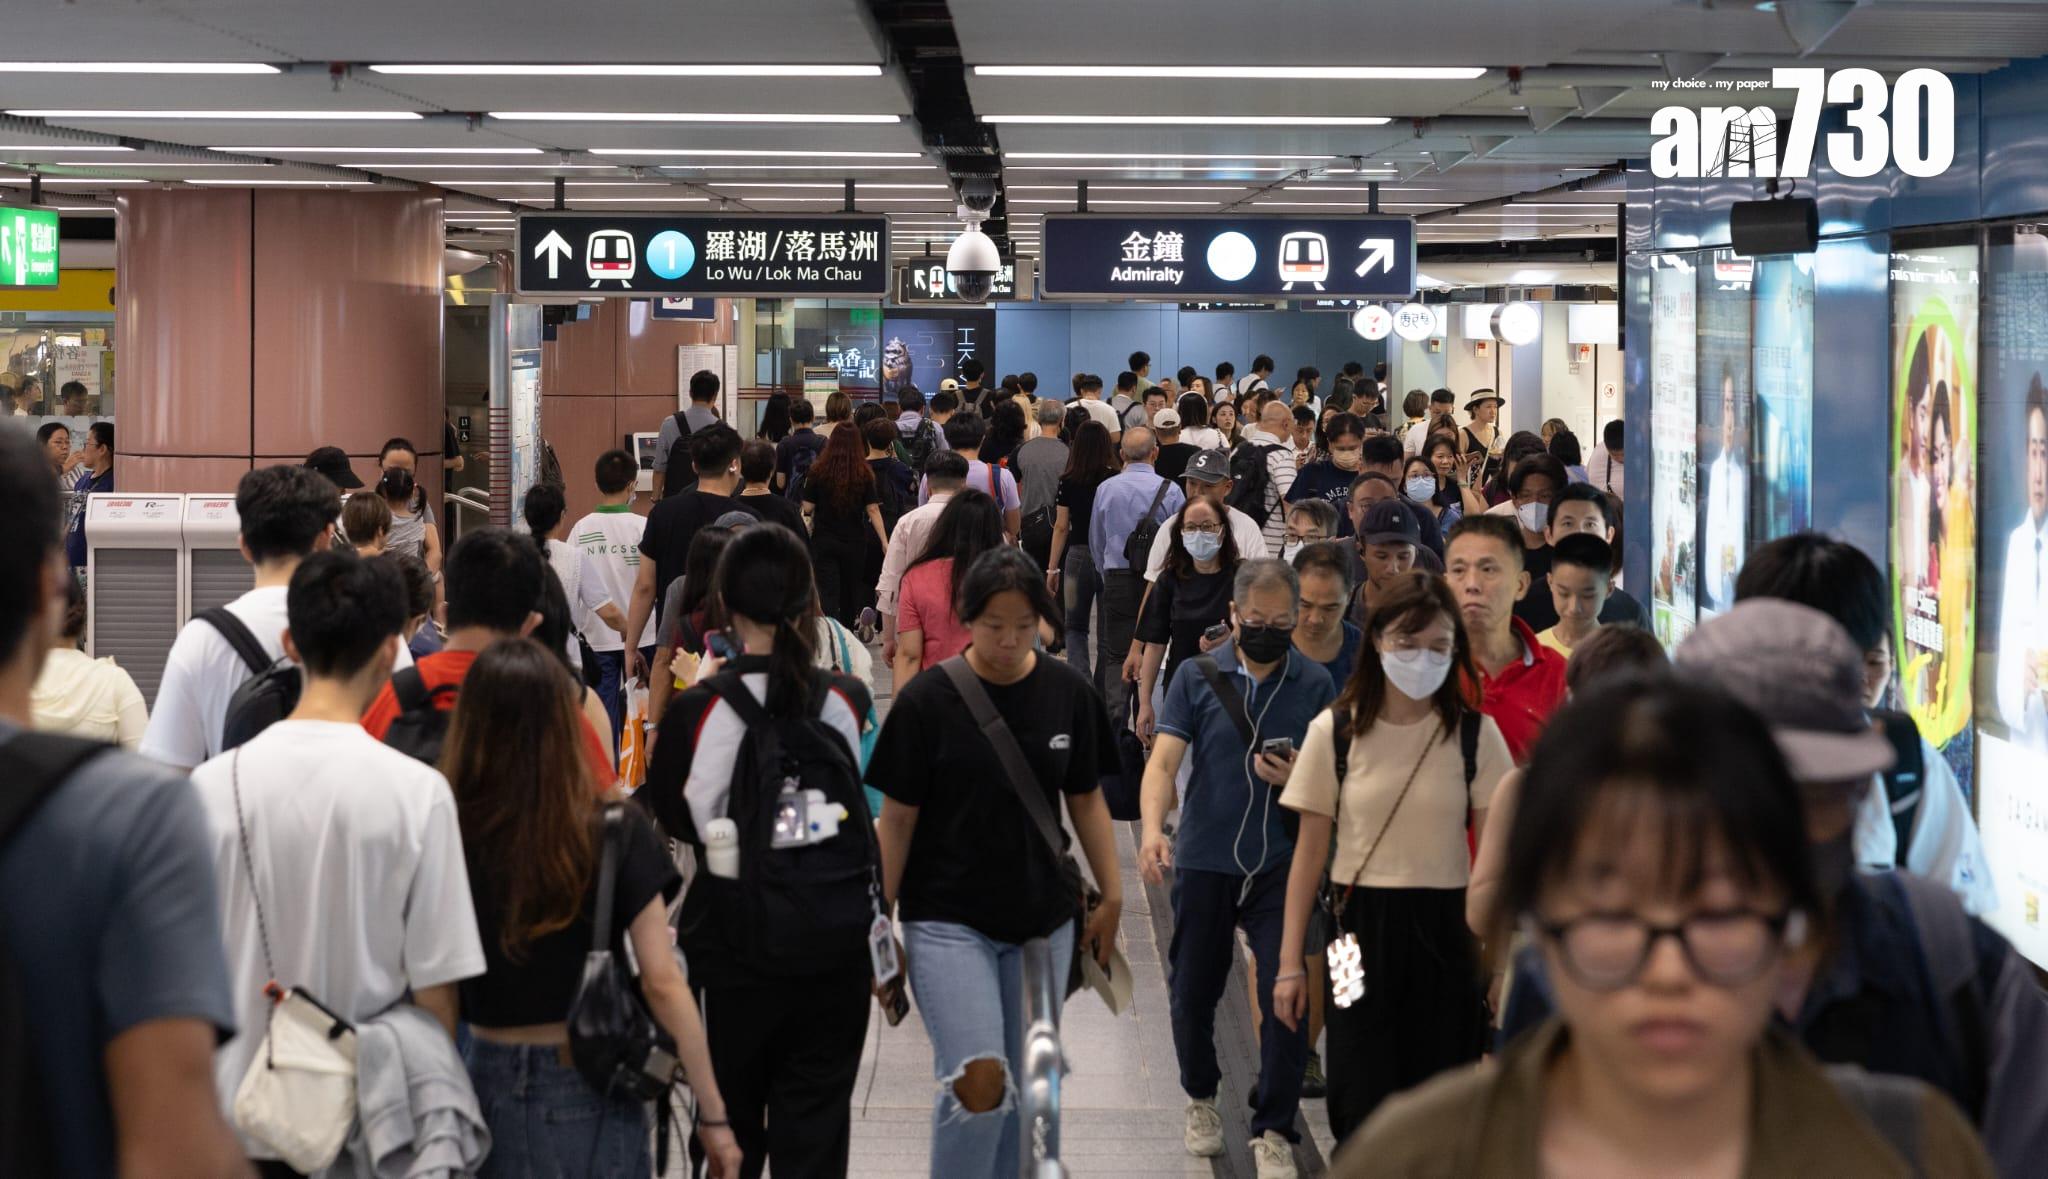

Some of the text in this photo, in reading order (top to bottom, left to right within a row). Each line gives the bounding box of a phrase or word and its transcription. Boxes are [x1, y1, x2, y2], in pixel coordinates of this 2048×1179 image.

[705, 230, 879, 263] 羅湖/落馬洲
[1120, 231, 1185, 263] 金鐘
[706, 266, 725, 280] Lo
[727, 266, 752, 281] Wu
[765, 265, 792, 281] Lok
[797, 266, 820, 281] Ma
[823, 266, 862, 281] Chau
[1110, 265, 1185, 286] Admiralty
[1196, 455, 1208, 468] S
[587, 544, 638, 556] NWCSS
